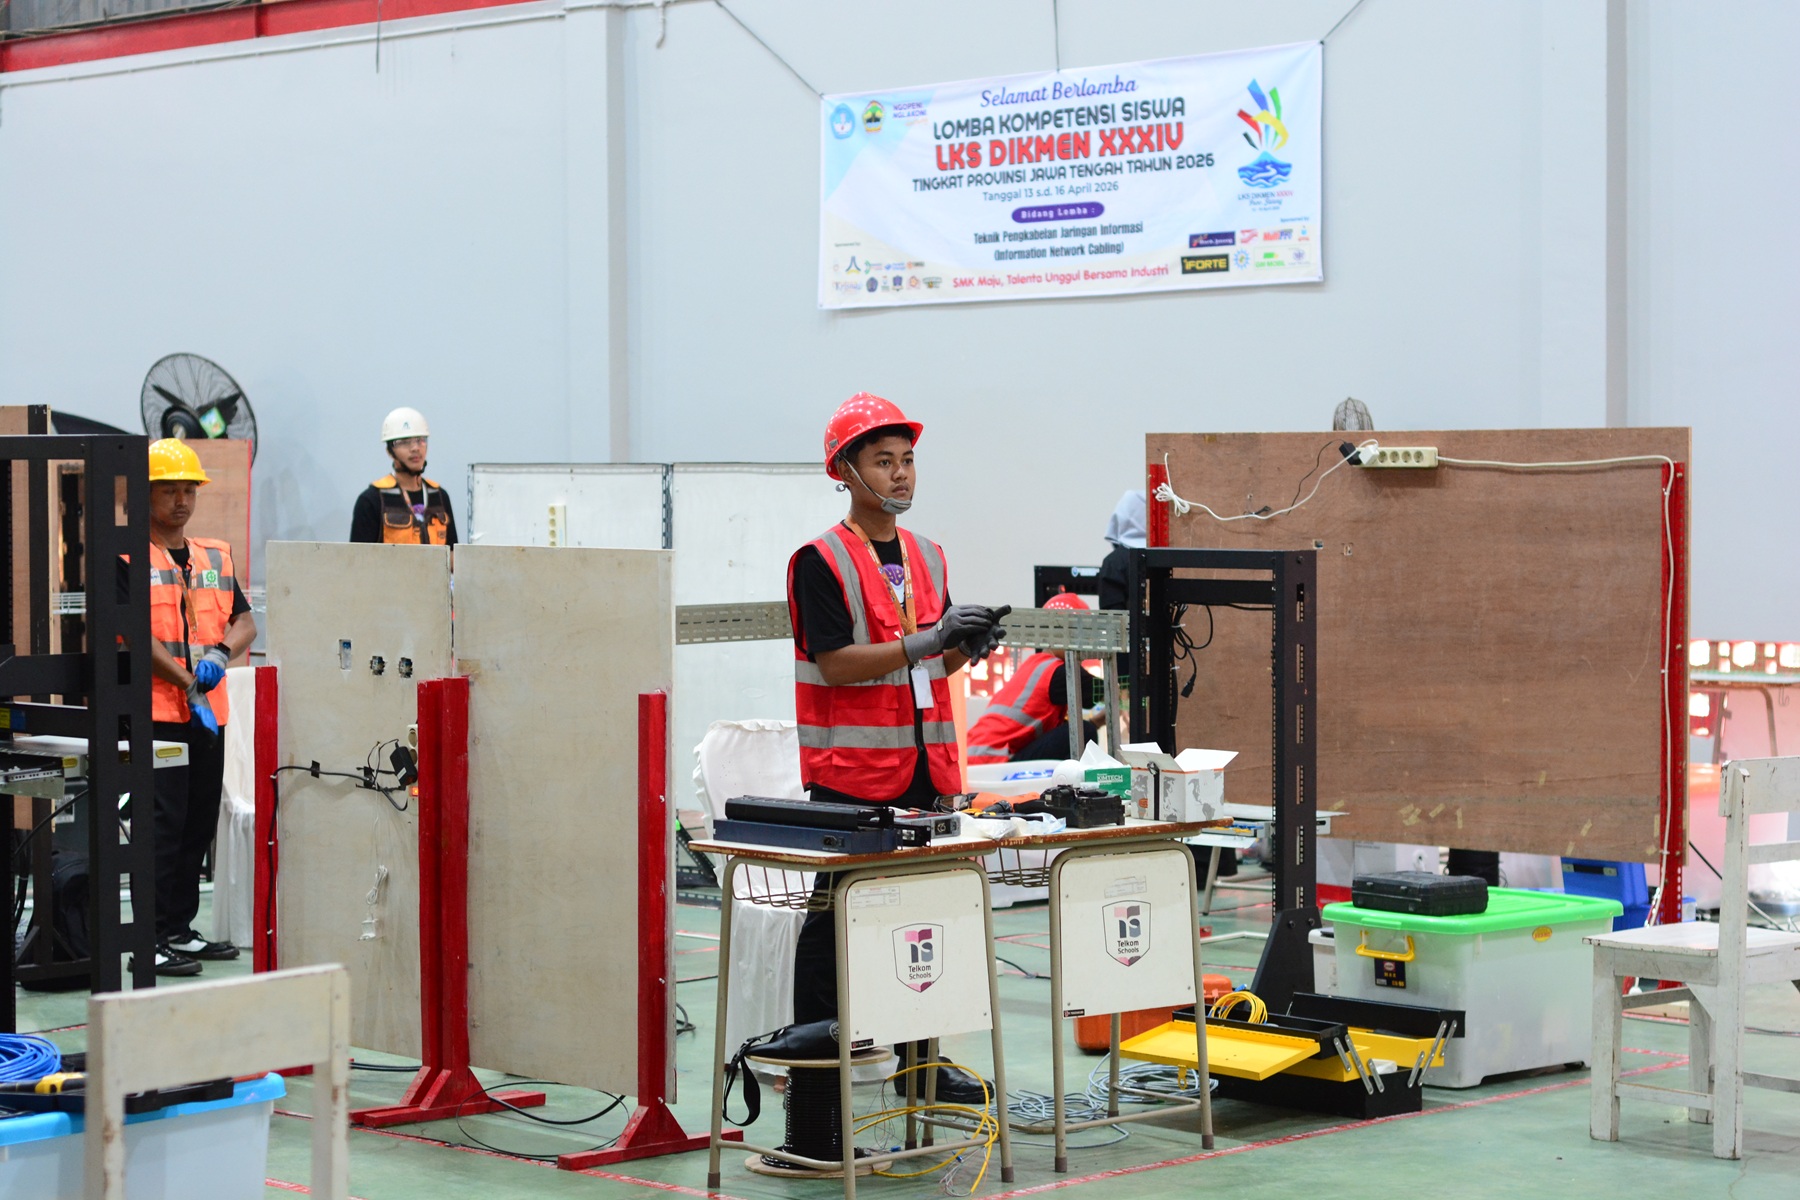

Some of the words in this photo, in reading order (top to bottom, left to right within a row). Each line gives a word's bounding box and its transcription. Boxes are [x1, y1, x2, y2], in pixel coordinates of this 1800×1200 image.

[980, 87, 1048, 108] Selamat
[1052, 75, 1138, 100] Berlomba
[934, 116, 994, 140] LOMBA
[999, 104, 1116, 134] KOMPETENSI
[1121, 97, 1185, 122] SISWA
[935, 141, 982, 171] LKS
[989, 130, 1091, 167] DIKMEN
[1098, 122, 1183, 157] XXXIV
[912, 174, 963, 192] TINGKAT
[967, 169, 1026, 187] PROVINSI
[1030, 165, 1067, 182] JAWA
[1070, 162, 1123, 179] TENGAH
[1127, 156, 1172, 173] TAHUN
[1176, 153, 1215, 170] 2026
[983, 189, 1022, 202] Tanggal
[1024, 187, 1034, 198] 13
[1036, 186, 1053, 197] s.d.
[1055, 185, 1065, 196] 16
[1068, 181, 1092, 196] April
[1094, 181, 1119, 192] 2026
[1021, 208, 1054, 219] Bidang
[1057, 206, 1088, 217] Lomba
[973, 231, 1000, 245] Teknik
[1003, 227, 1057, 243] Pengkabelan
[1060, 224, 1097, 239] Jaringan
[1100, 221, 1143, 236] Informasi
[994, 246, 1047, 261] (Information
[1050, 243, 1085, 258] Network
[1088, 241, 1124, 255] Cabling)
[952, 277, 974, 288] SMK
[977, 276, 1004, 287] Maju,
[1007, 273, 1042, 285] Talenta
[1045, 270, 1081, 285] Unggul
[1083, 269, 1128, 281] Bersama
[1131, 264, 1169, 277] Industri
[908, 964, 932, 972] Telkom
[908, 972, 932, 980] Schools
